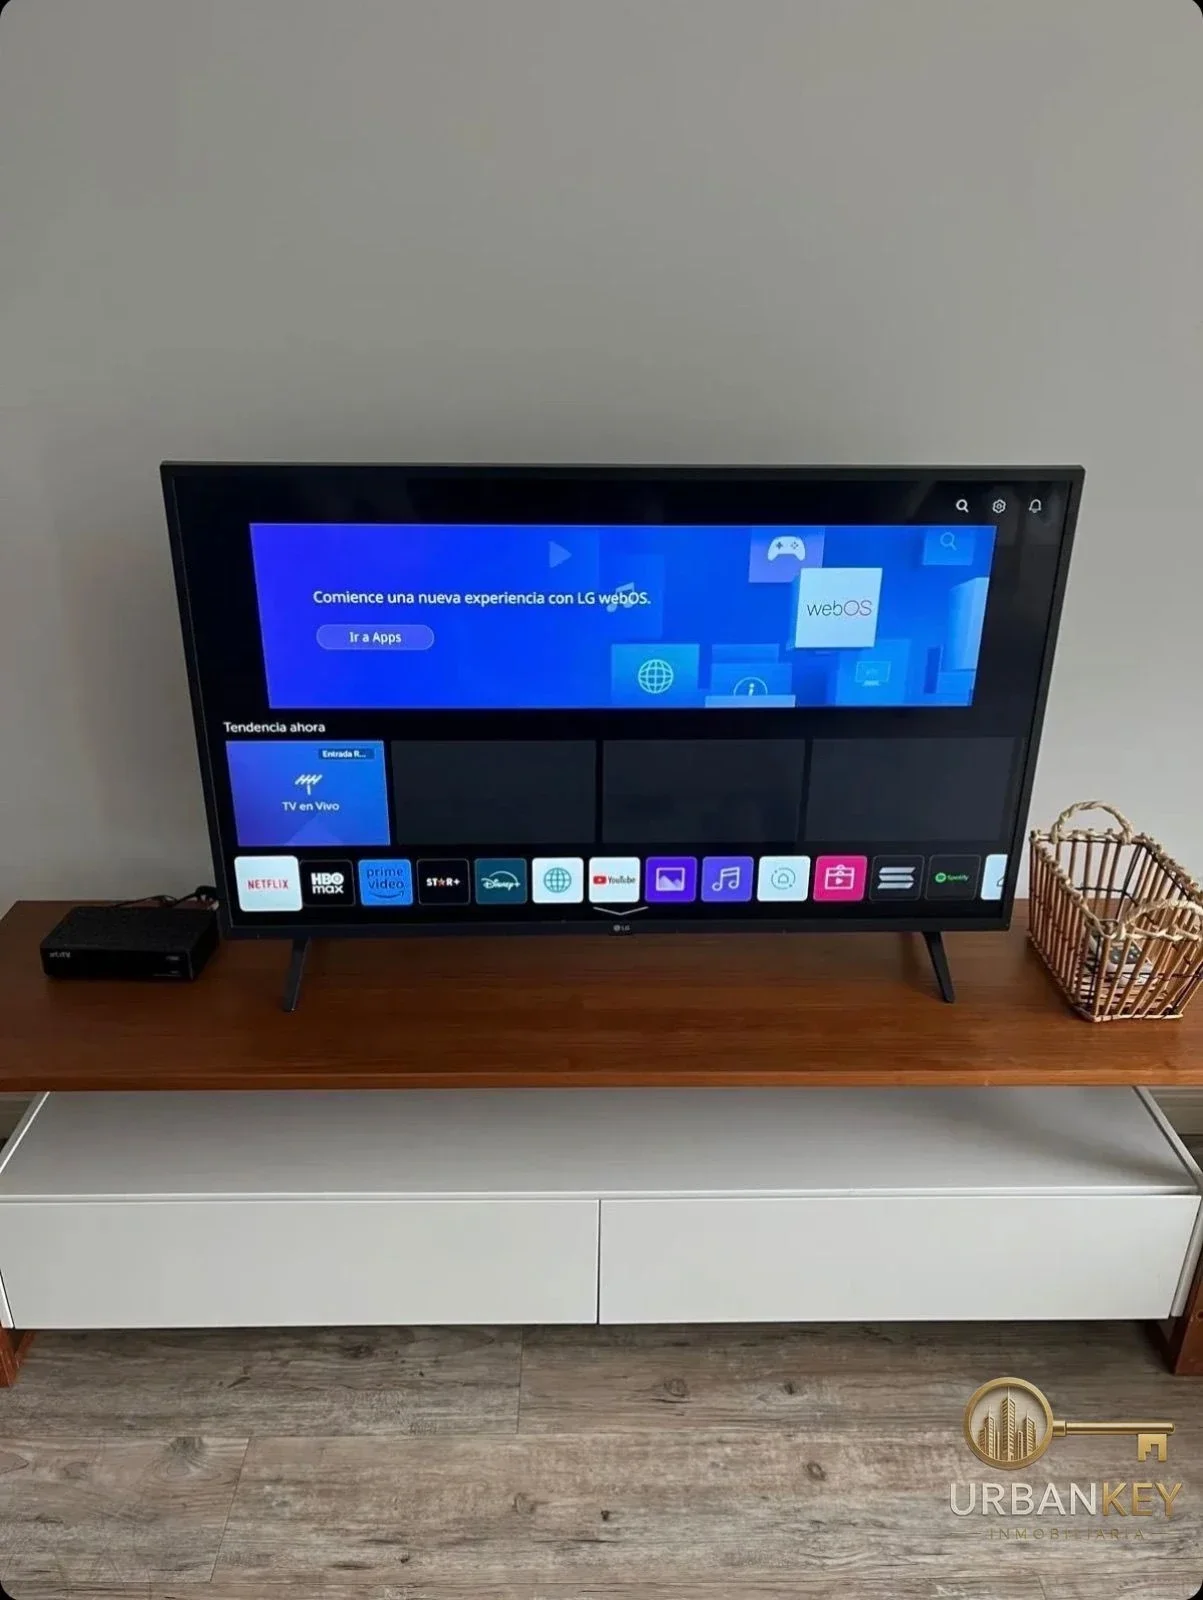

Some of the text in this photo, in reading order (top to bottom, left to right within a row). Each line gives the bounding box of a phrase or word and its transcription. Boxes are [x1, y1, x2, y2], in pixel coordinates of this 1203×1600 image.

[313, 590, 651, 608] Comience una nueva experiencia con LG webOS.
[806, 600, 872, 616] webOS
[349, 631, 402, 646] Ir a Apps
[223, 721, 326, 733] Tendencia ahora
[322, 750, 352, 758] Entrada
[282, 801, 340, 811] TV en Vivo
[310, 872, 344, 885] HBO
[366, 866, 404, 879] prime
[947, 873, 969, 884] Spotify
[248, 878, 289, 890] NETFLIX
[368, 877, 405, 890] video
[482, 876, 521, 891] Disney+
[607, 874, 636, 885] YouTube
[312, 885, 344, 895] max
